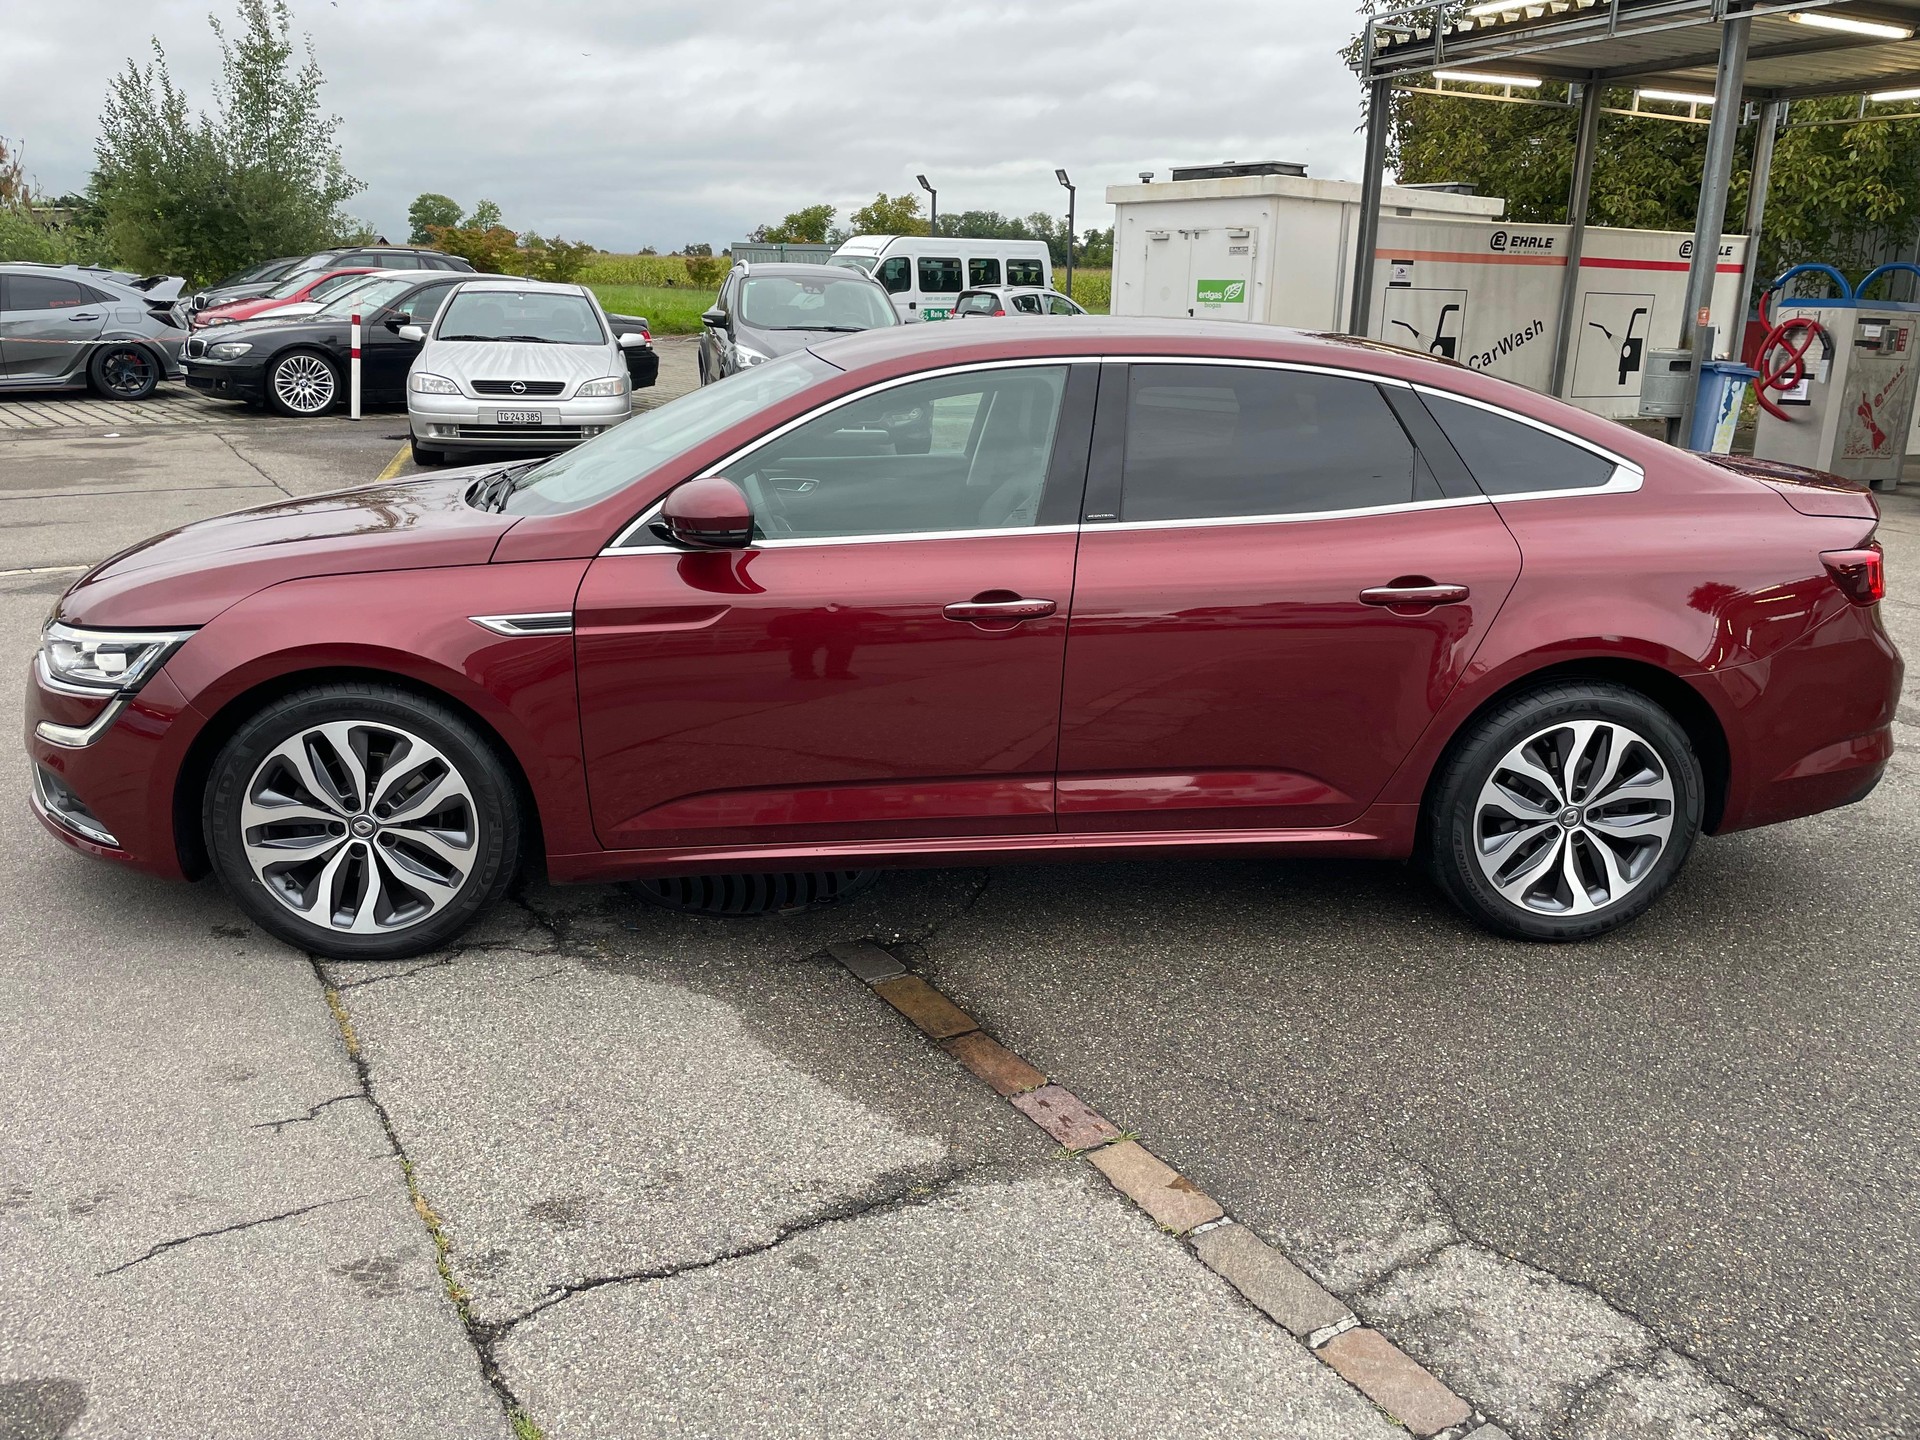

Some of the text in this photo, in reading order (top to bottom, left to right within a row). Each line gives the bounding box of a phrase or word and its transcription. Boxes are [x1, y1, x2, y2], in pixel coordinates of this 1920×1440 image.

[1510, 236, 1554, 248] EHRLE
[1198, 291, 1223, 300] erdgas
[1469, 319, 1544, 369] CarWash
[466, 813, 502, 903] FULDA
